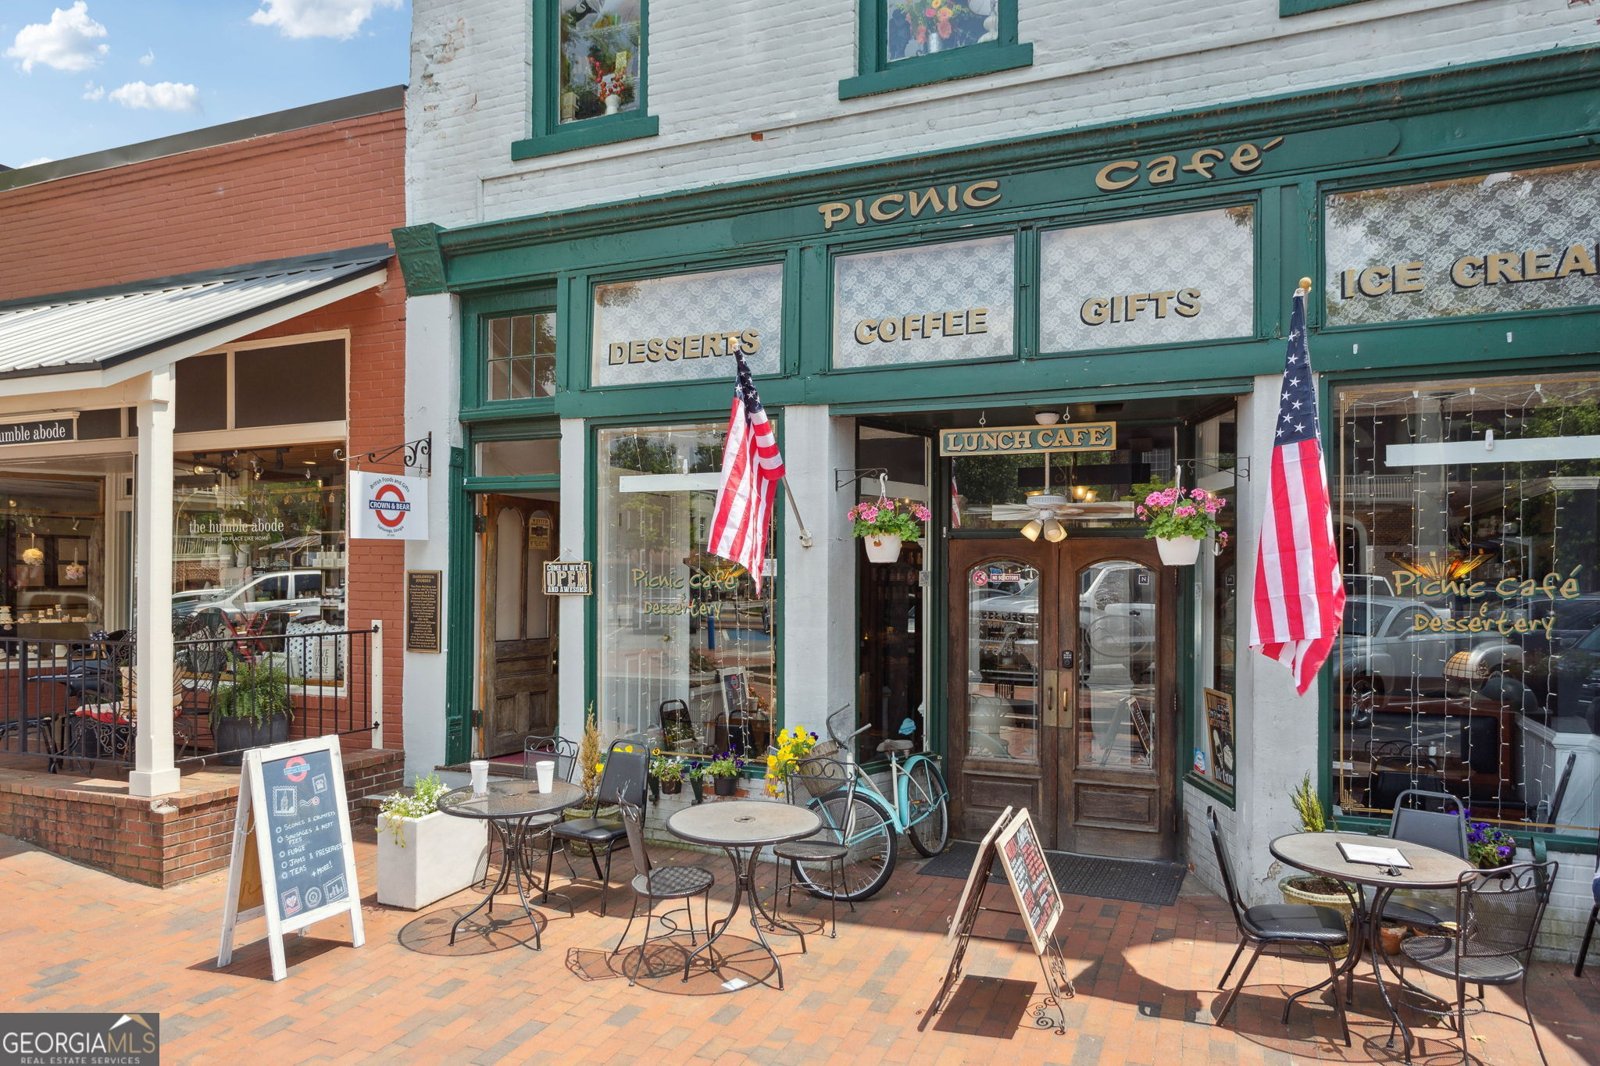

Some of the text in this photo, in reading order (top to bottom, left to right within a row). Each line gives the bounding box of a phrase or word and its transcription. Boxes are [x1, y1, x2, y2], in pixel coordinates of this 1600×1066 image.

[817, 179, 1002, 231] PICNIC
[1341, 243, 1600, 300] ICE CREA
[1081, 288, 1202, 326] GIFTS
[854, 307, 989, 345] COFFEE
[608, 327, 762, 366] DESSERTS
[33, 422, 66, 441] abode
[947, 431, 1032, 452] LUNCH
[369, 501, 390, 509] CROWN
[396, 503, 410, 511] BEAR
[189, 517, 284, 533] the humble abode
[547, 570, 588, 587] OPEN
[631, 568, 685, 589] Picnic
[1392, 564, 1583, 600] Picnic Café
[643, 598, 722, 620] Dessertery
[1414, 610, 1556, 640] Dessertery
[289, 856, 306, 867] JAMS
[289, 865, 307, 877] TEAS
